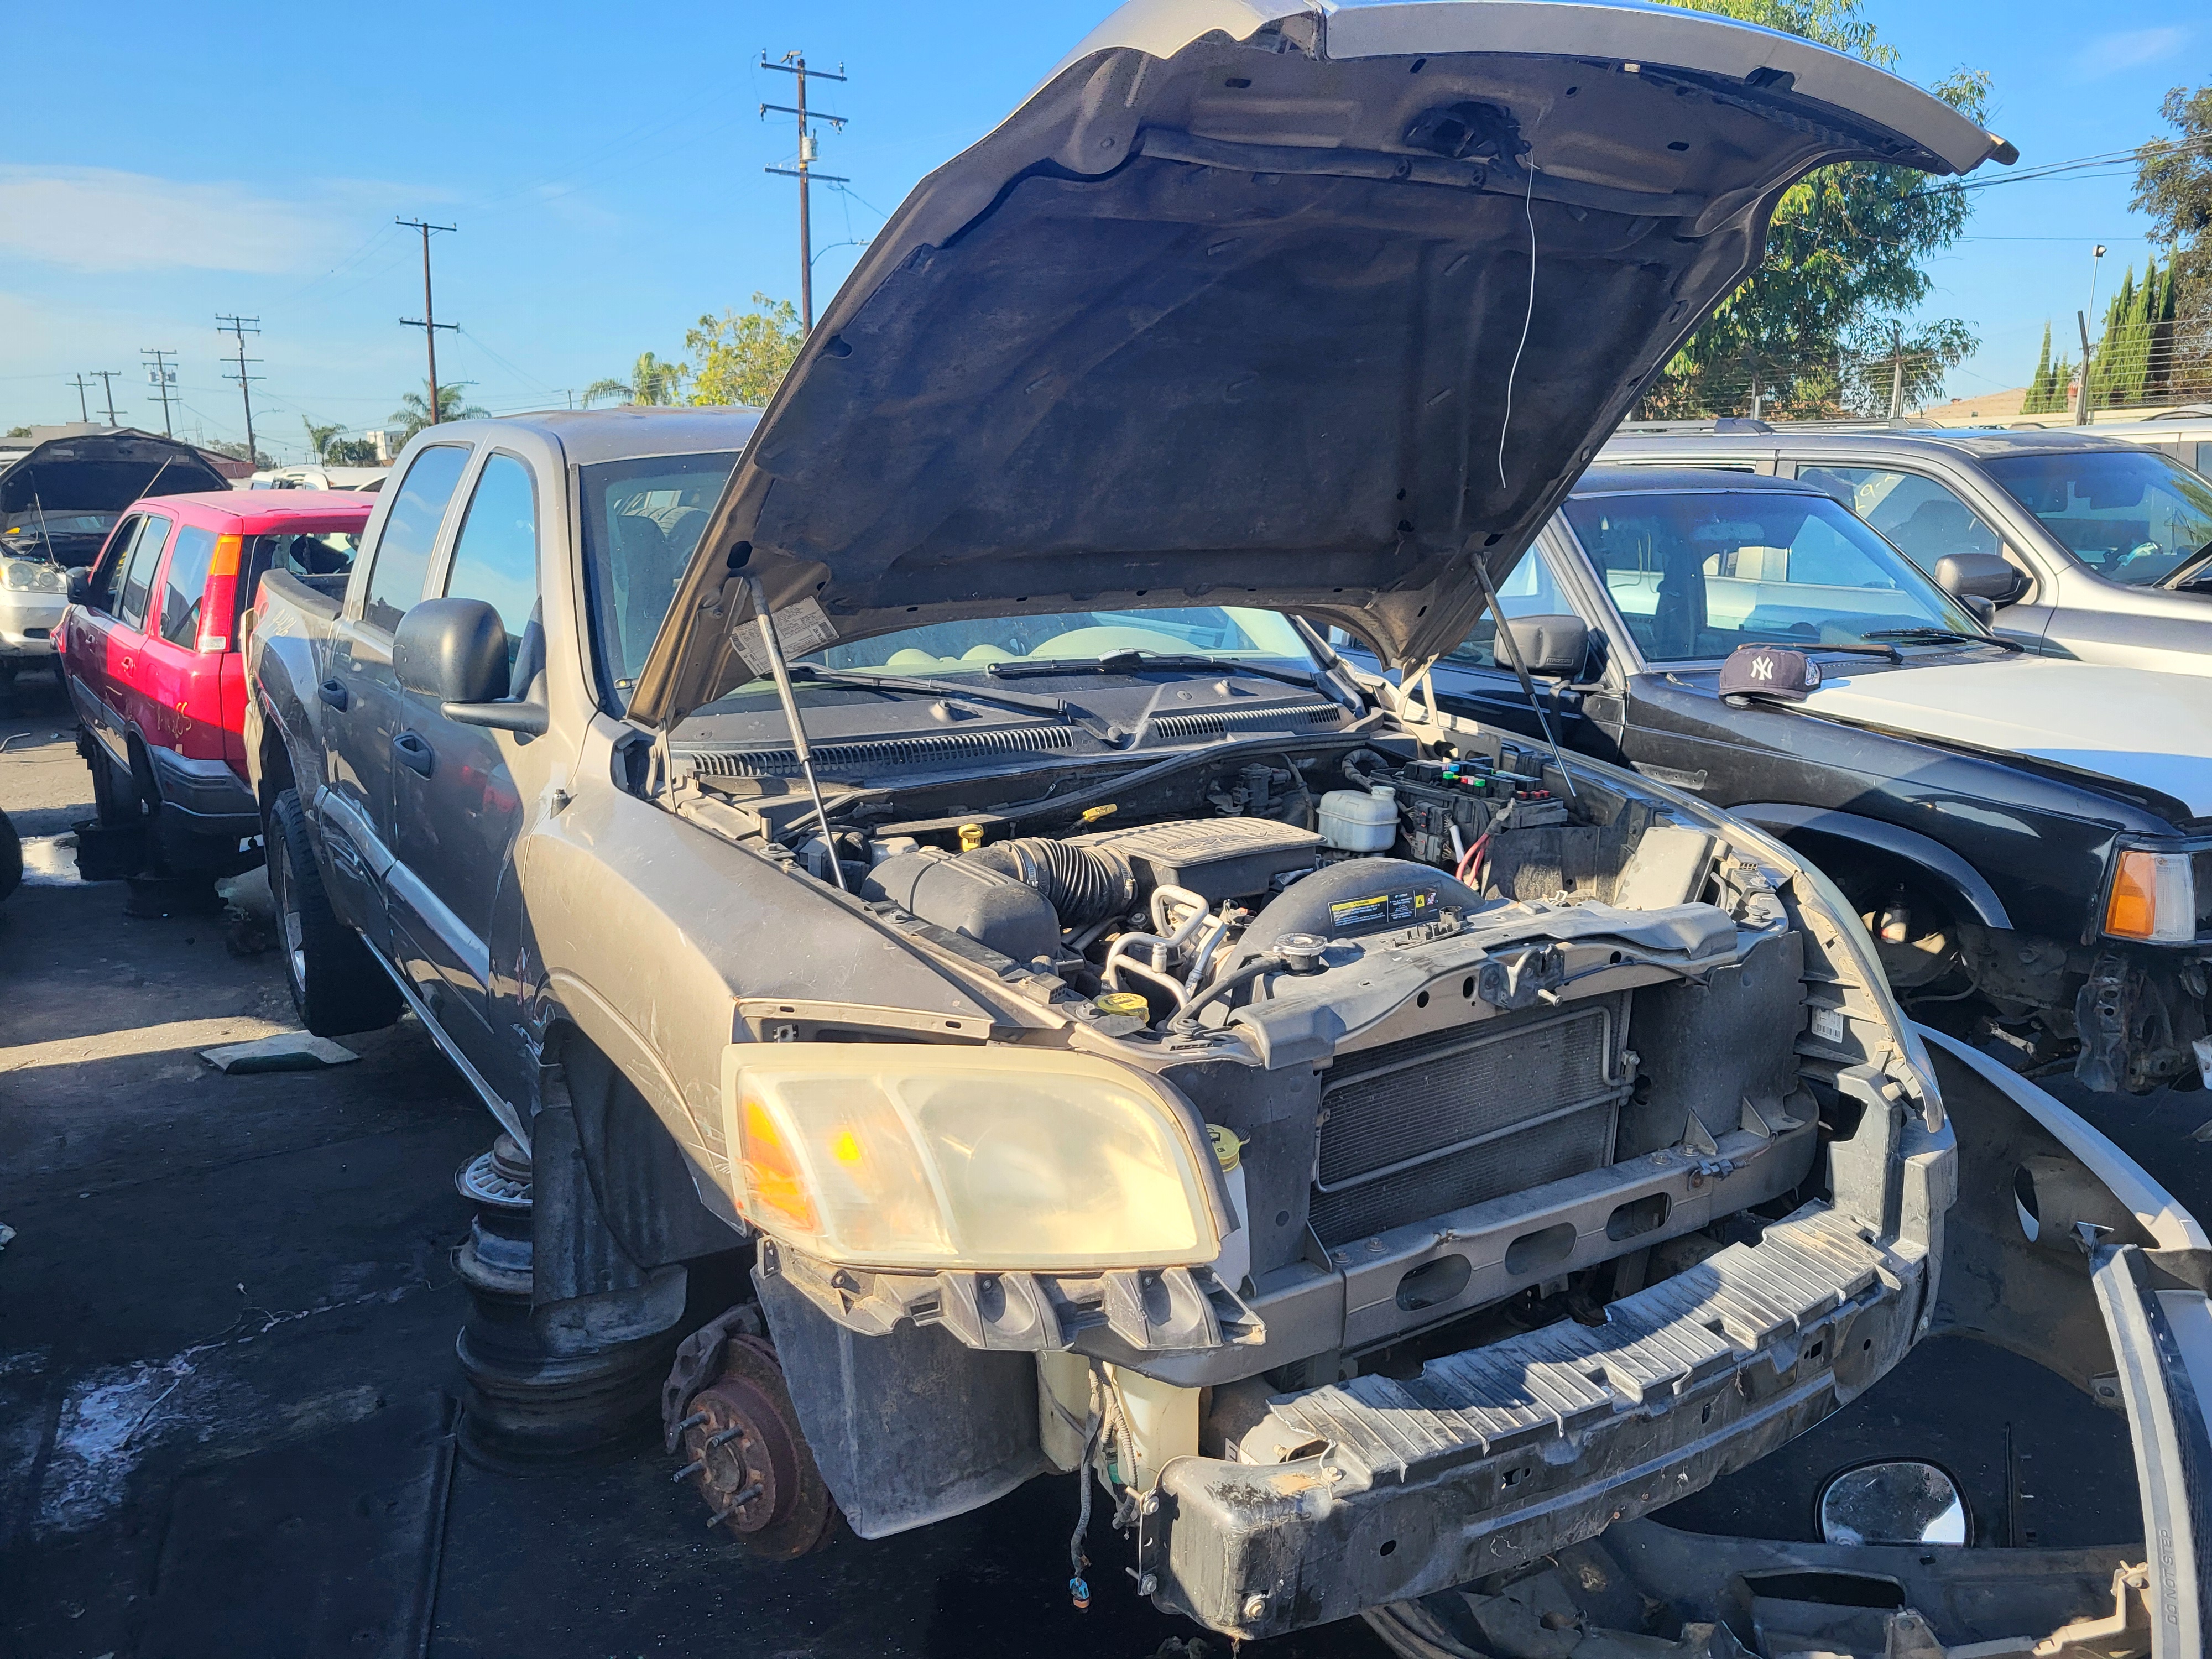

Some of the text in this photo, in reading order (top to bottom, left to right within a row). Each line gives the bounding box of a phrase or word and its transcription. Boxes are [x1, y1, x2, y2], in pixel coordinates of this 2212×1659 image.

[1750, 655, 1774, 681] NY
[1245, 829, 1293, 839] V8
[2159, 1529, 2177, 1625] DO NOT STEP
